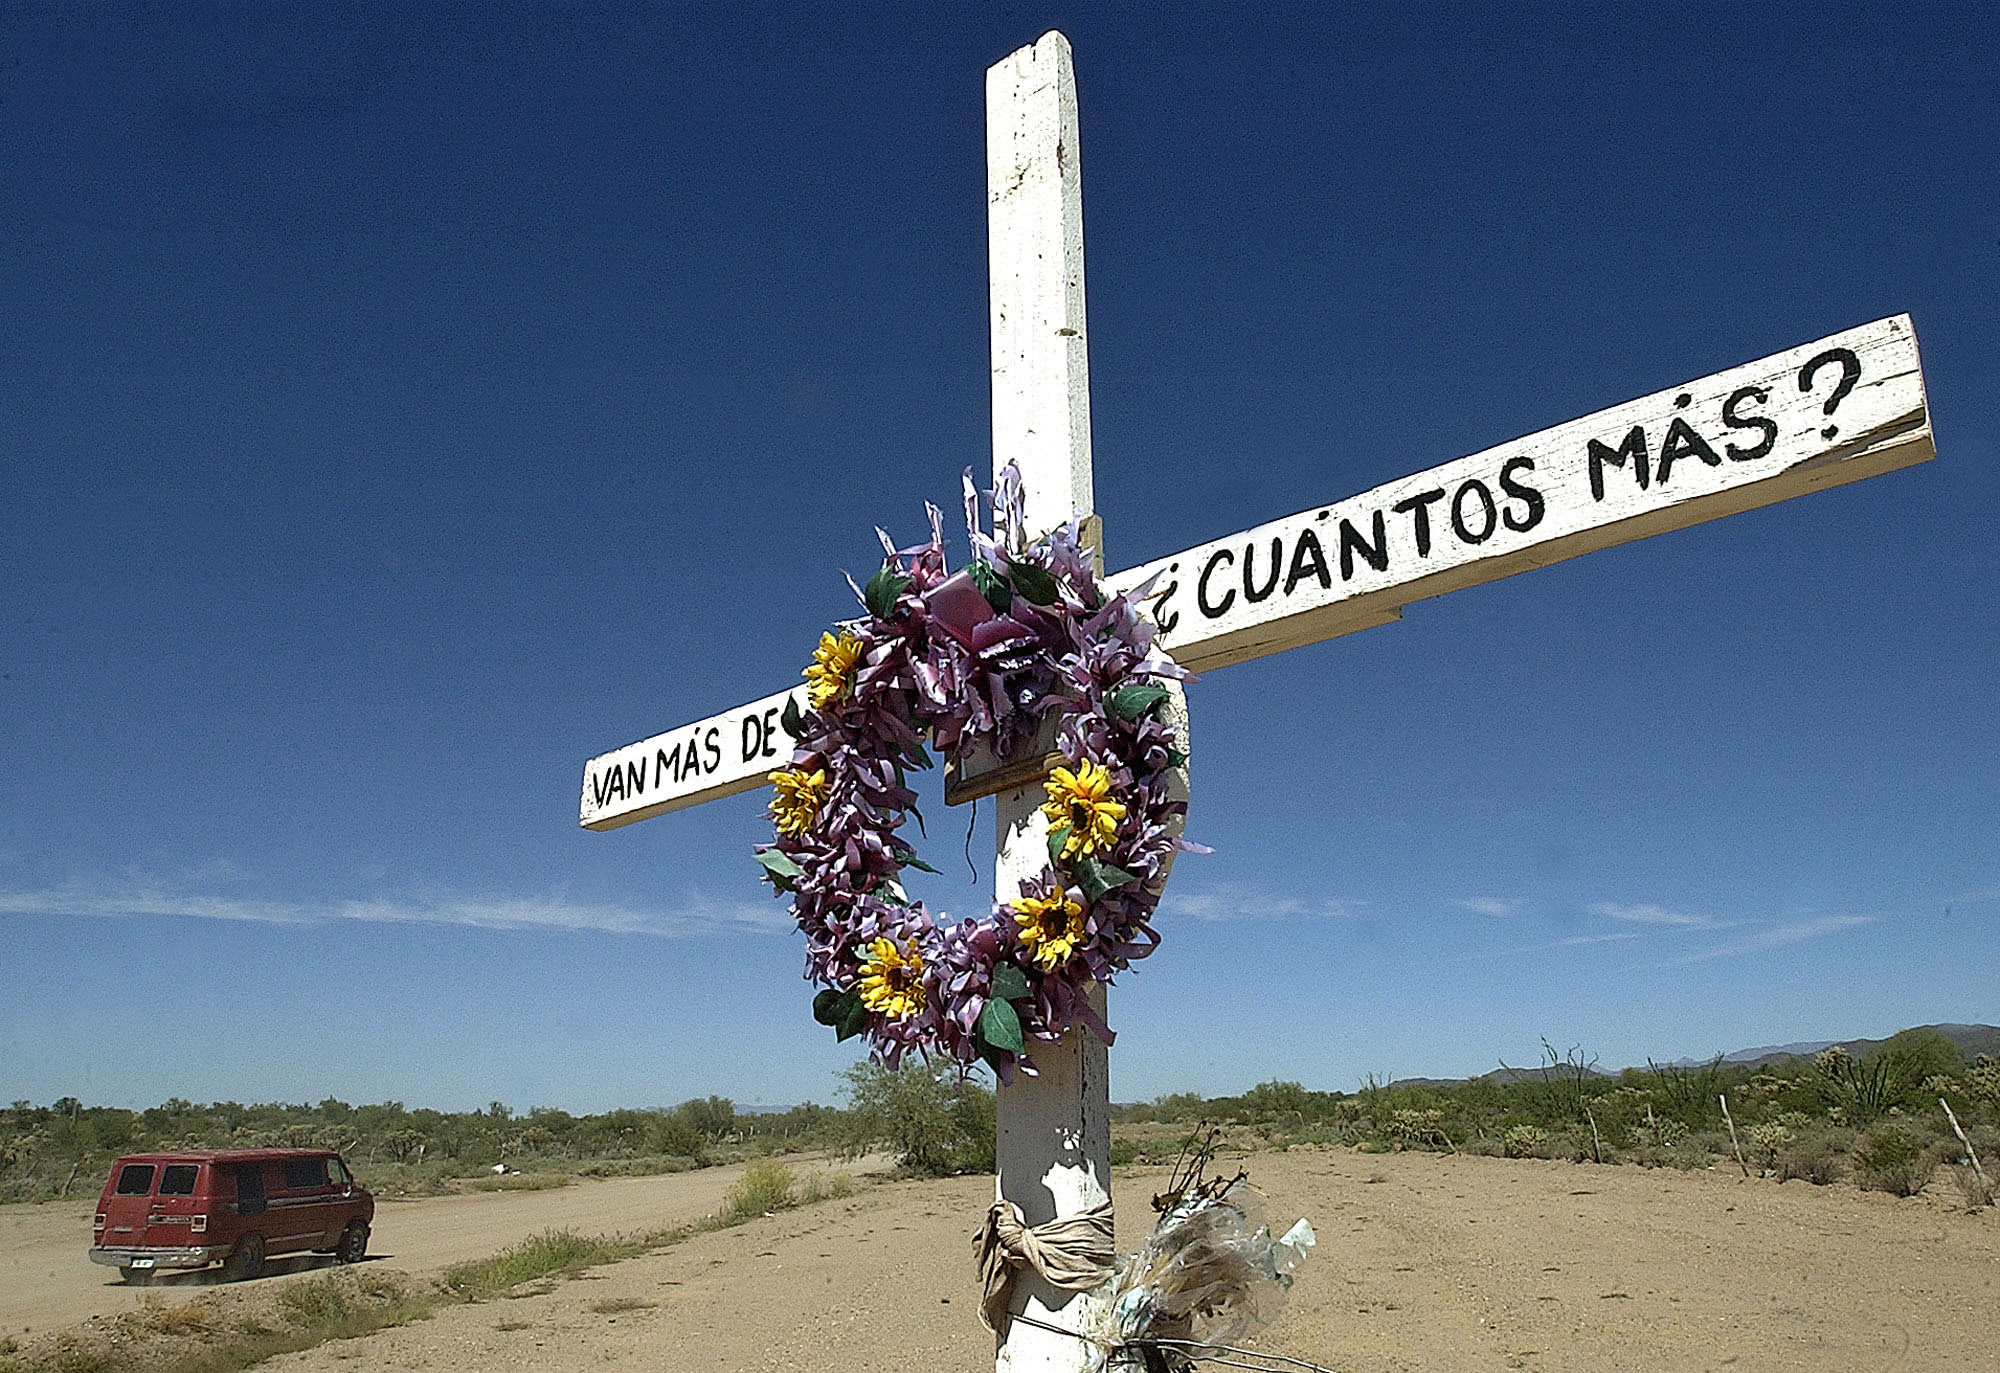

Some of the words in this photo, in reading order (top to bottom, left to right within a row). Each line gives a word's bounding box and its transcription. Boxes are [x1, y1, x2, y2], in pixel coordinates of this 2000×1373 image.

[1587, 347, 1861, 501] MÁS?
[593, 756, 647, 809] VAN
[655, 727, 720, 789] MÁS
[742, 707, 778, 763] DE
